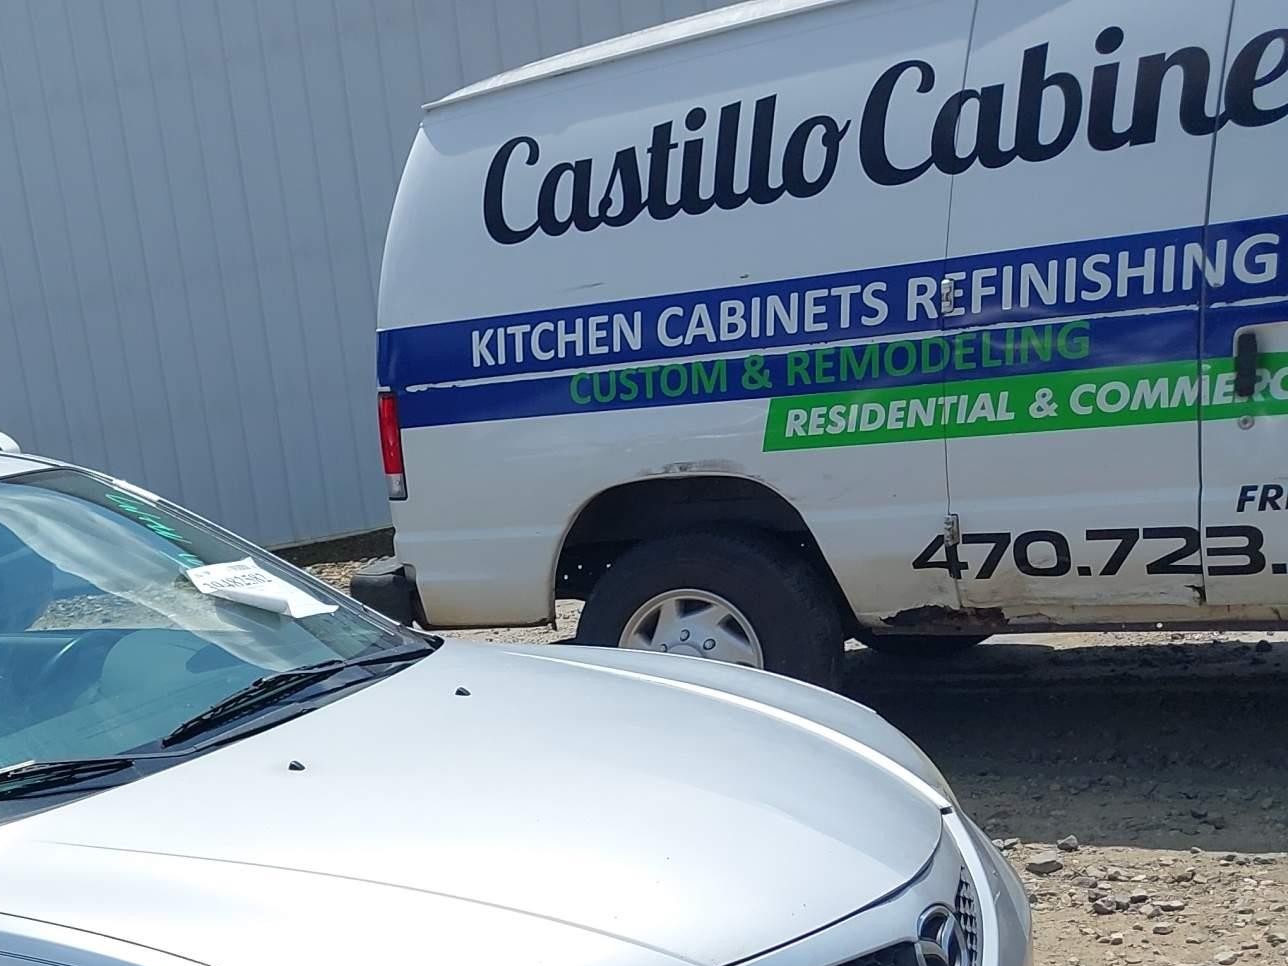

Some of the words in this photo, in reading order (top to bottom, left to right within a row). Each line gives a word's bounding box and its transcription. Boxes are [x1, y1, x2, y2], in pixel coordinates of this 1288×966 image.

[483, 93, 852, 245] Castillo
[859, 25, 1288, 187] Cabine
[471, 310, 643, 368] KITCHEN
[656, 281, 889, 348] CABINETS
[906, 232, 1280, 322] REFINISHING
[569, 358, 728, 405] CUSTOM
[741, 354, 773, 391] &
[786, 319, 1092, 387] REMODELING
[783, 390, 1016, 438] RESIDENTIAL
[1028, 387, 1058, 418] &
[1235, 483, 1288, 513] FR
